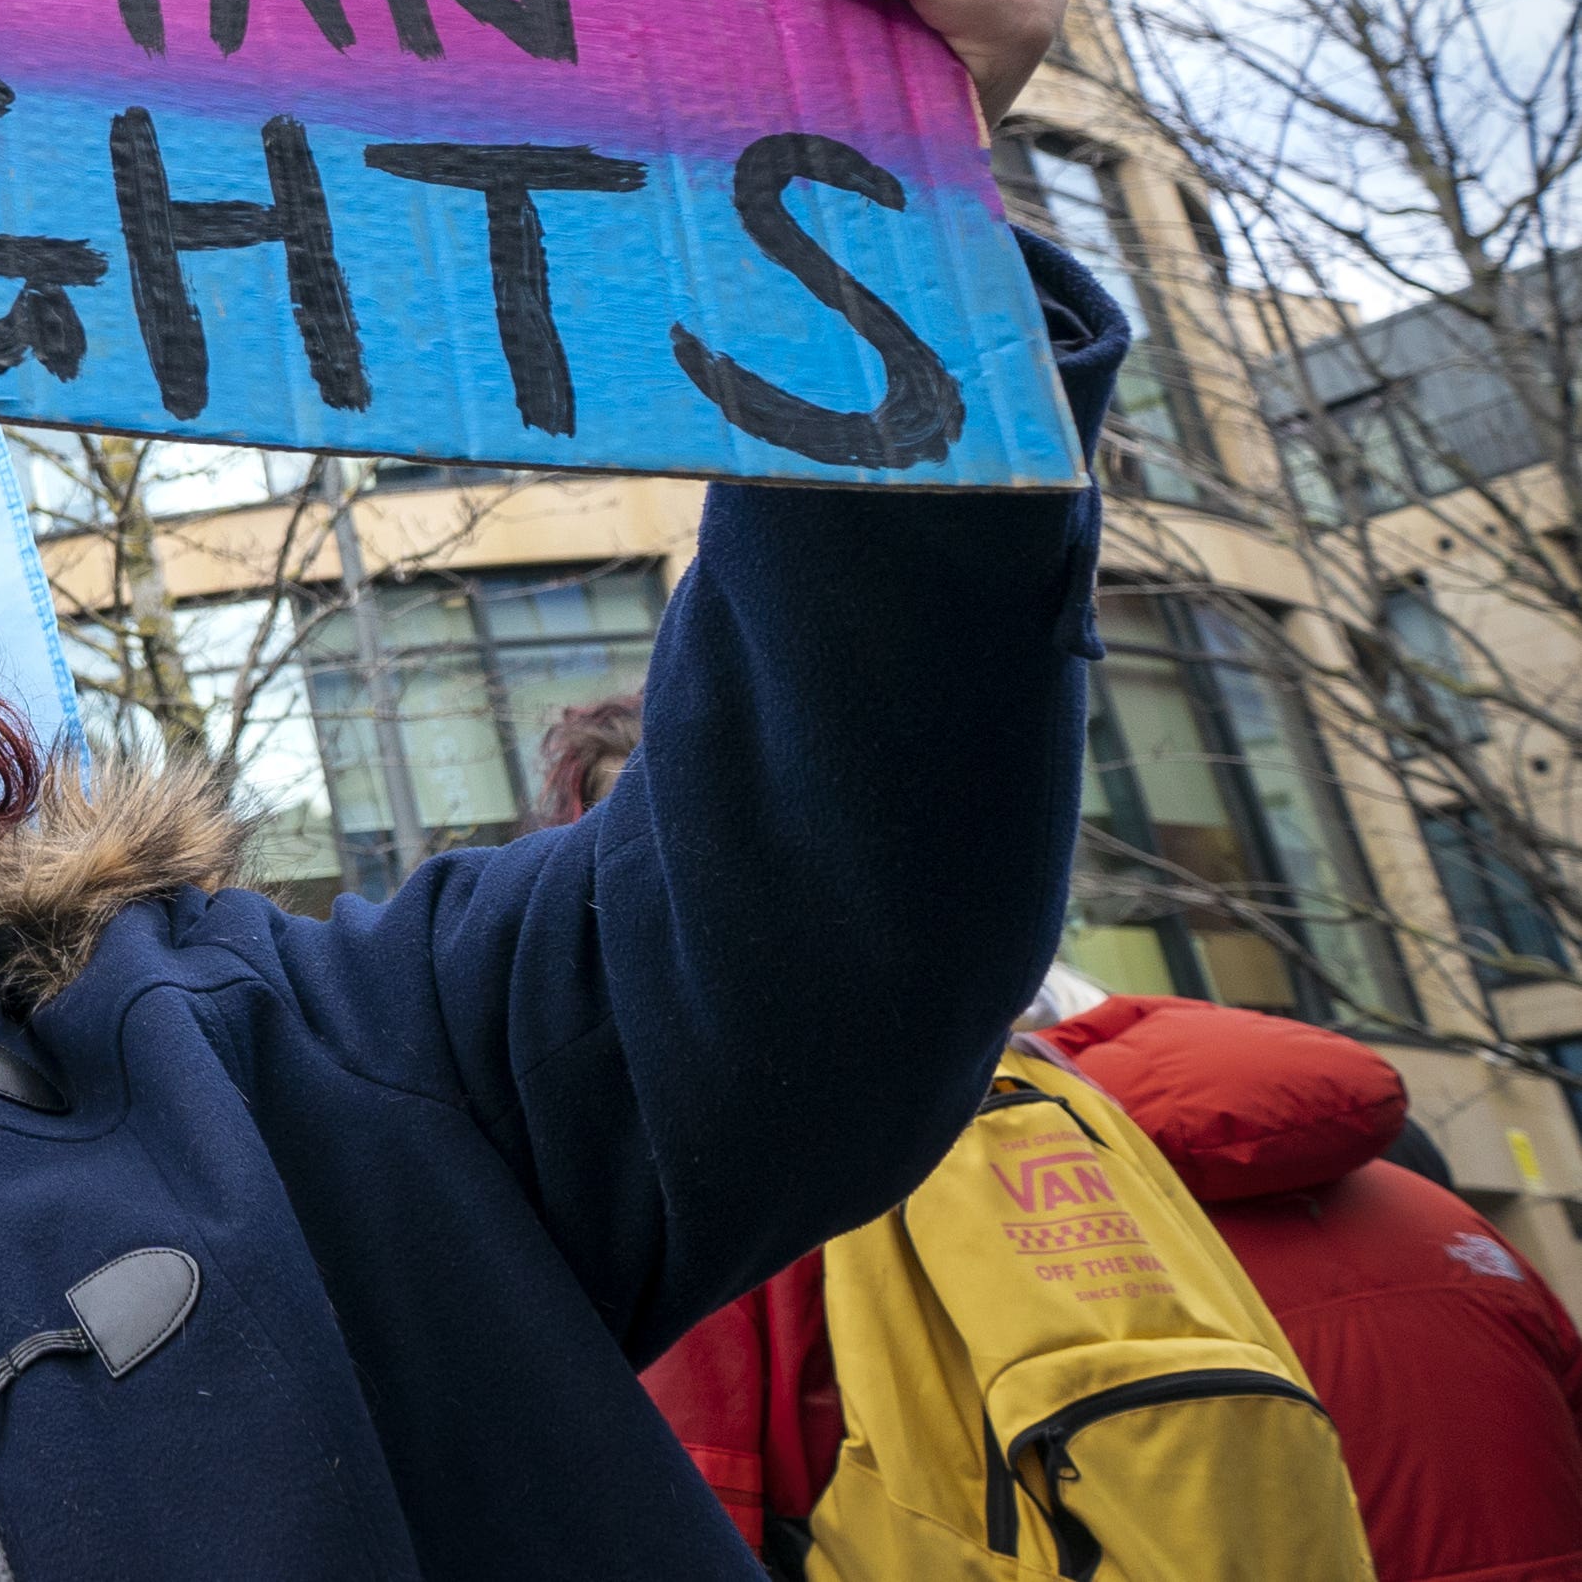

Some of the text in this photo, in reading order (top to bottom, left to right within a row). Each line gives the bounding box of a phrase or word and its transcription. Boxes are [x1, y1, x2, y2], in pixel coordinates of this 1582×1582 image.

[989, 1152, 1118, 1214] VAN
[1035, 1254, 1168, 1282] OFF THE WA
